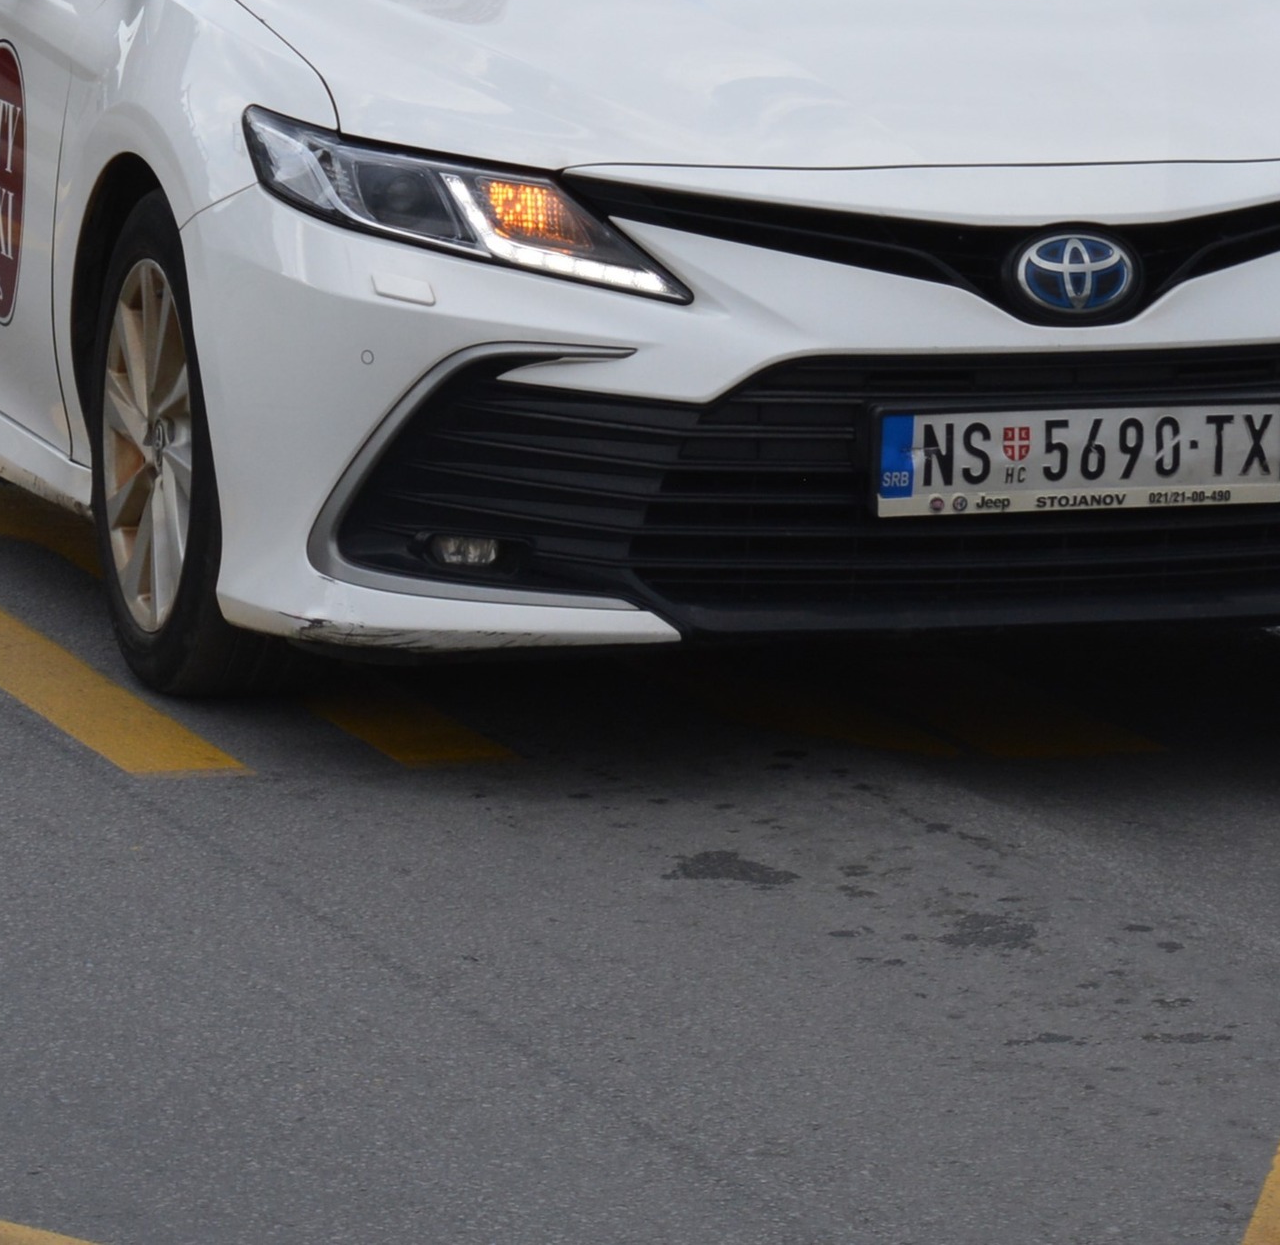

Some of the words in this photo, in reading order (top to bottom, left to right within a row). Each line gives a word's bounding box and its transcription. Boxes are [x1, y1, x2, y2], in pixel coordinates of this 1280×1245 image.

[923, 422, 991, 487] NS
[882, 471, 910, 487] SRB
[975, 495, 1011, 510] Jeep
[1036, 493, 1127, 509] STOJANOV
